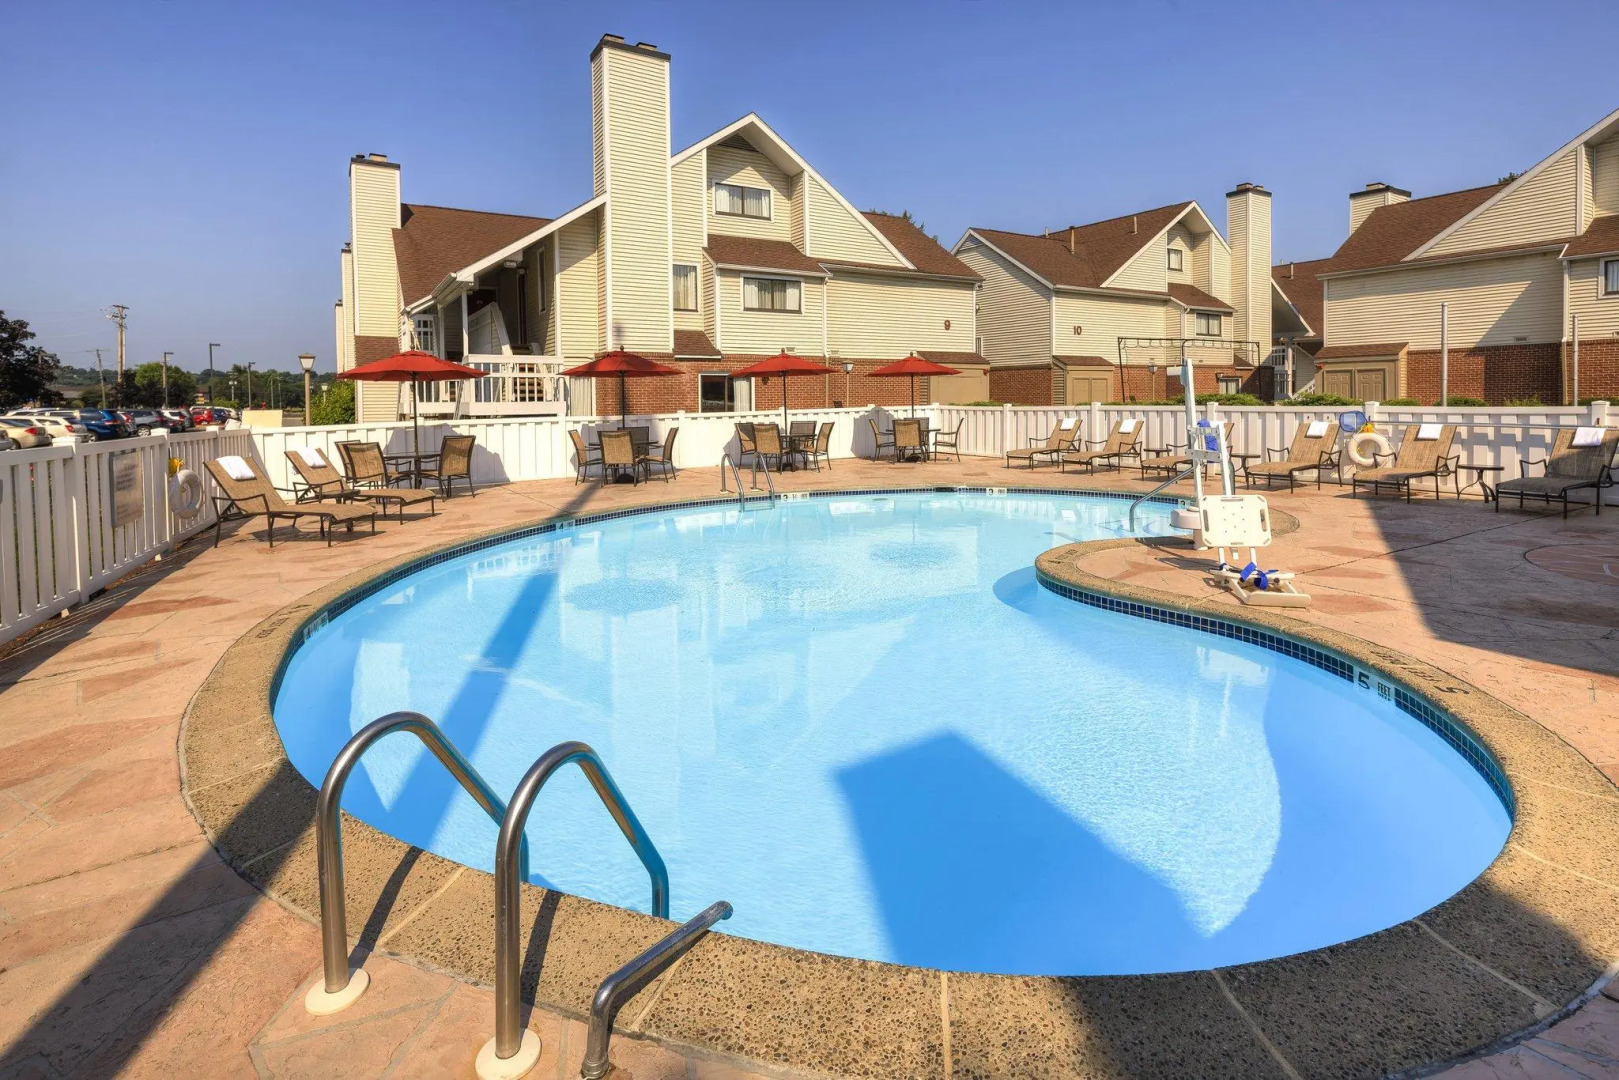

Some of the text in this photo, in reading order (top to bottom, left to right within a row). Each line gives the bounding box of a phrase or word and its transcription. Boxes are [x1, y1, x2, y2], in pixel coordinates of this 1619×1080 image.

[944, 319, 951, 331] 9
[1073, 325, 1082, 335] 10
[1358, 671, 1370, 690] 5
[1377, 682, 1391, 698] FEET
